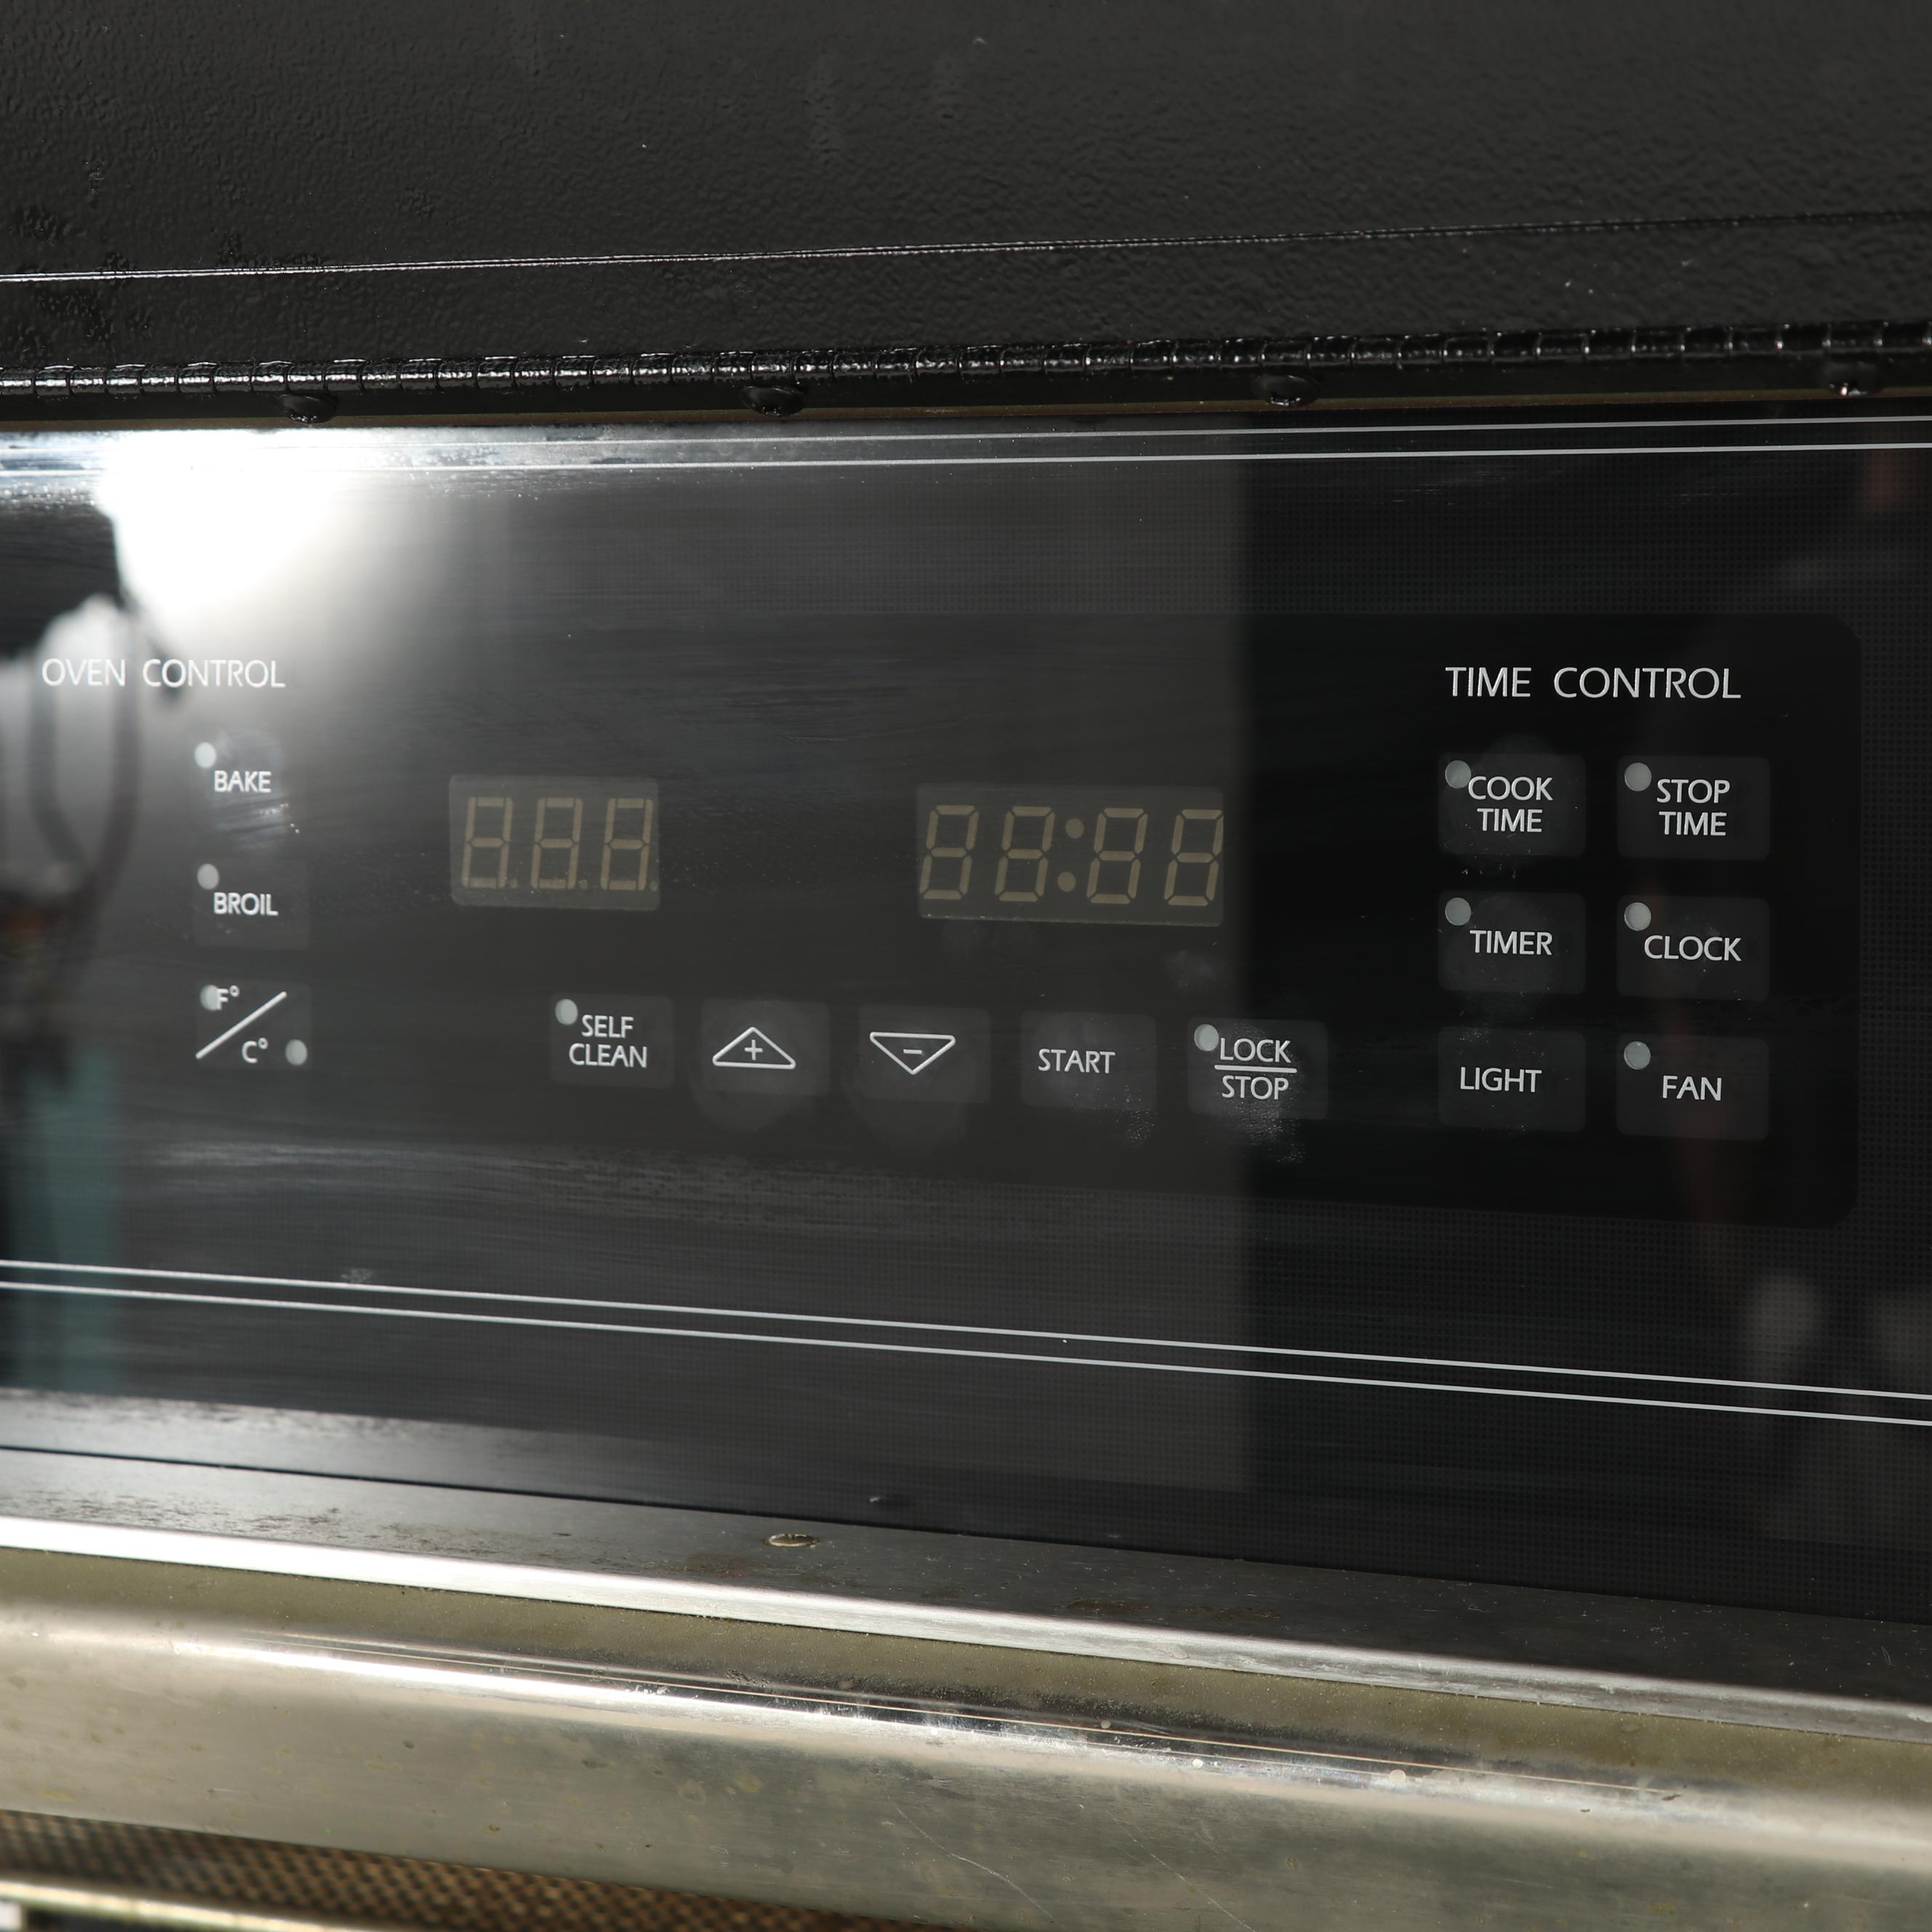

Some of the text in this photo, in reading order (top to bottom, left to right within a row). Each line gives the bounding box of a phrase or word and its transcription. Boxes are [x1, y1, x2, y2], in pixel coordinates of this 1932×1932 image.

[41, 658, 285, 687] OVEN CONTROL
[1445, 666, 1741, 699] TIME CONTROL
[214, 770, 271, 793] BAKE
[1468, 776, 1552, 801] COOK
[1656, 779, 1731, 804] STOP
[1477, 808, 1542, 832] TIME
[1659, 812, 1727, 837] TIME
[214, 893, 278, 916] BROIL
[1470, 930, 1552, 955] TIMER
[1644, 935, 1741, 962] CLOCK
[581, 1015, 634, 1038] SELF
[568, 1043, 647, 1068] CLEAN
[1037, 1049, 1116, 1074] START
[1219, 1038, 1292, 1063] LOCK
[1221, 1076, 1289, 1100] STOP
[1459, 1067, 1542, 1093] LIGHT
[1661, 1076, 1723, 1101] FAN
